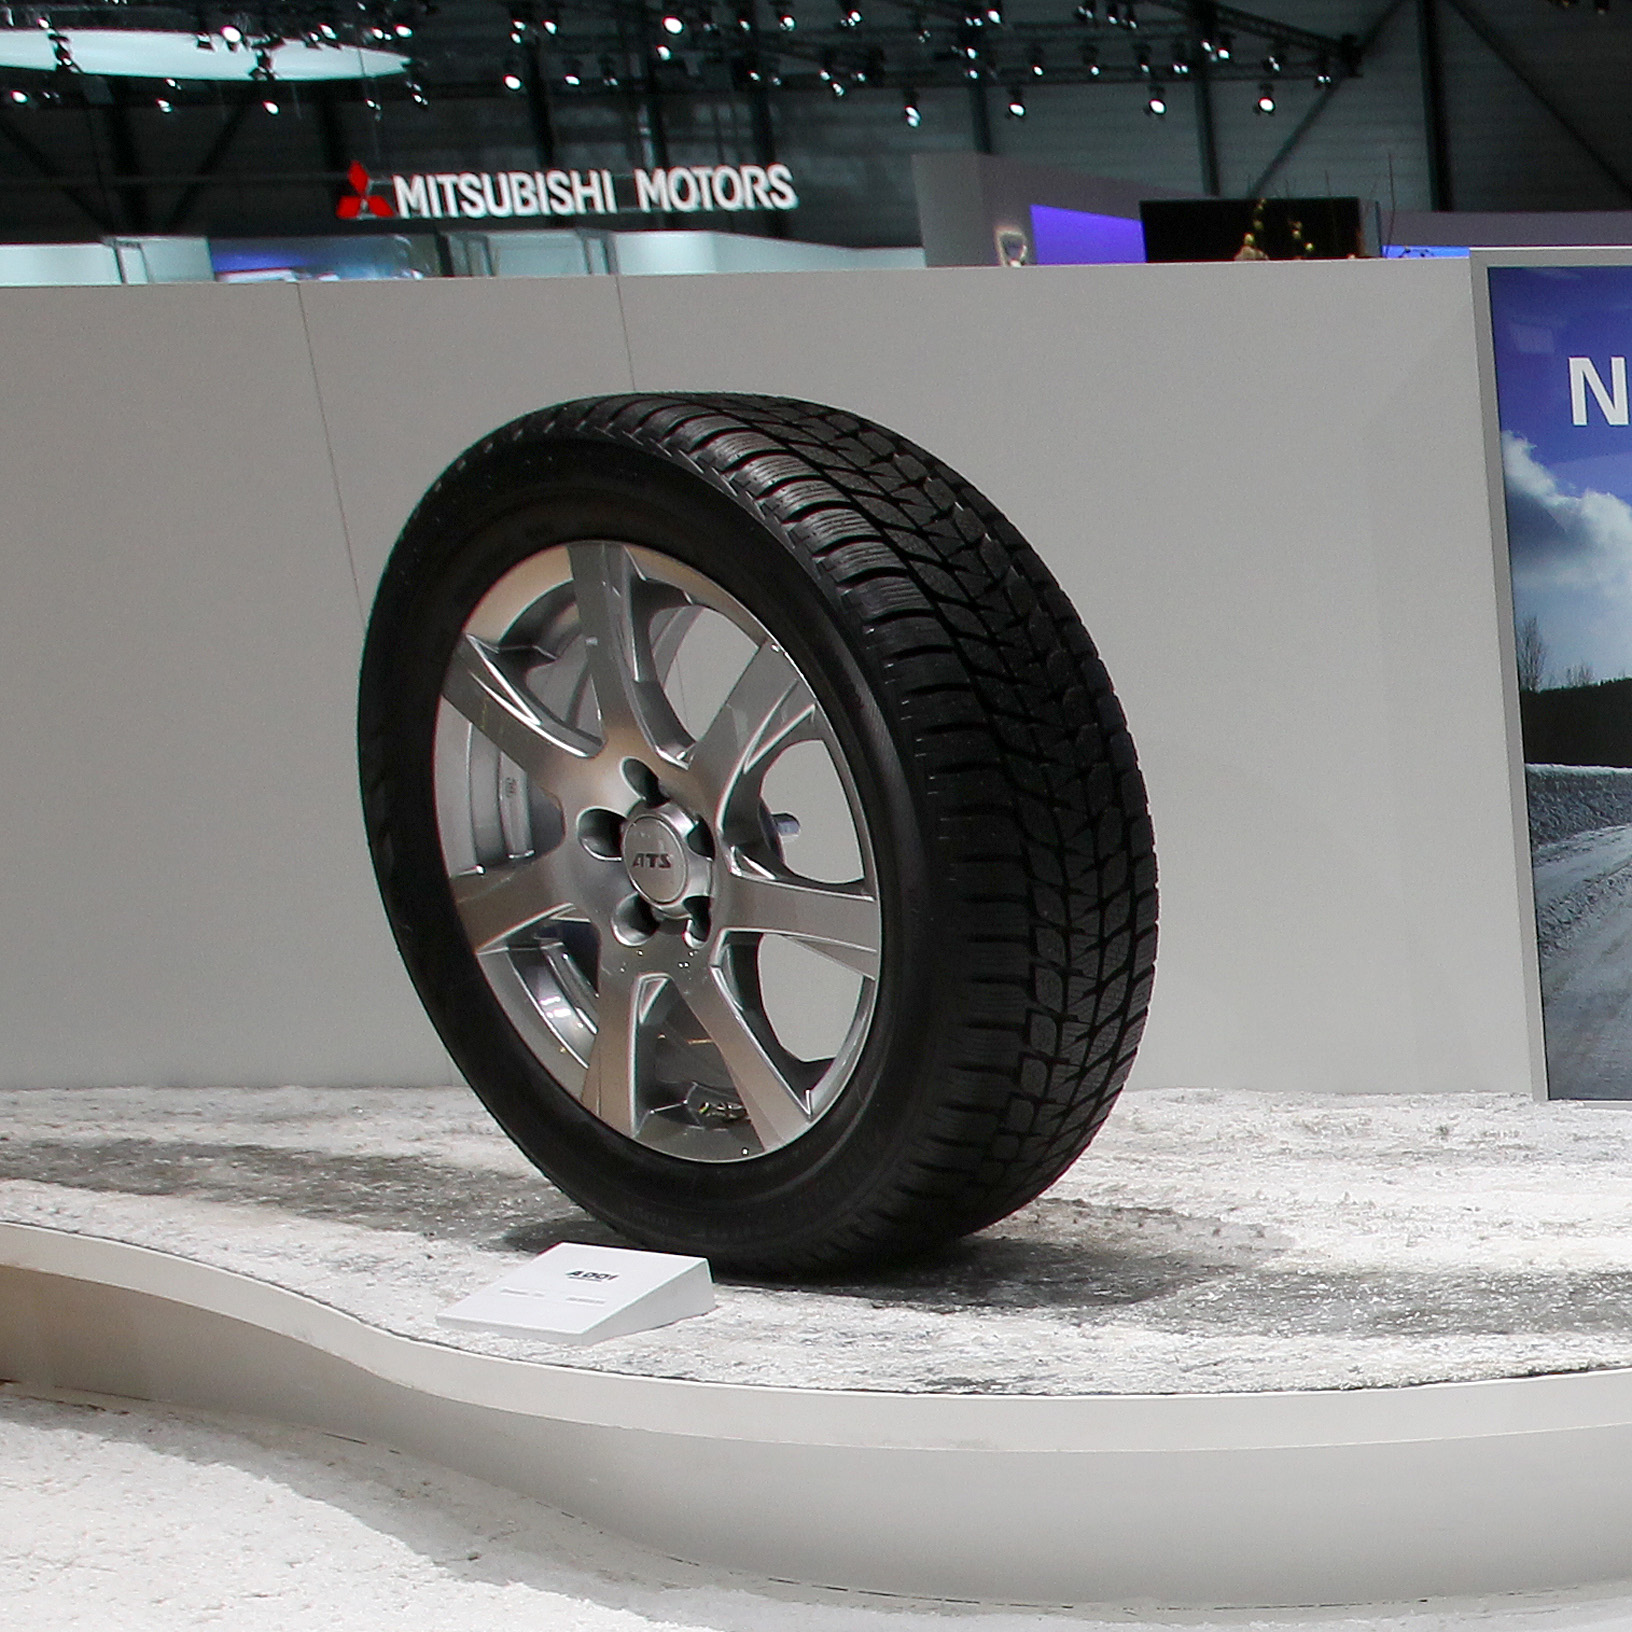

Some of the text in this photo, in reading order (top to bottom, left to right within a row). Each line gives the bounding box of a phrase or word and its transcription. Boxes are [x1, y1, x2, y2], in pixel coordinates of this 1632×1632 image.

[392, 163, 799, 219] MITSUBISHI MOTORS
[632, 853, 672, 869] ATS
